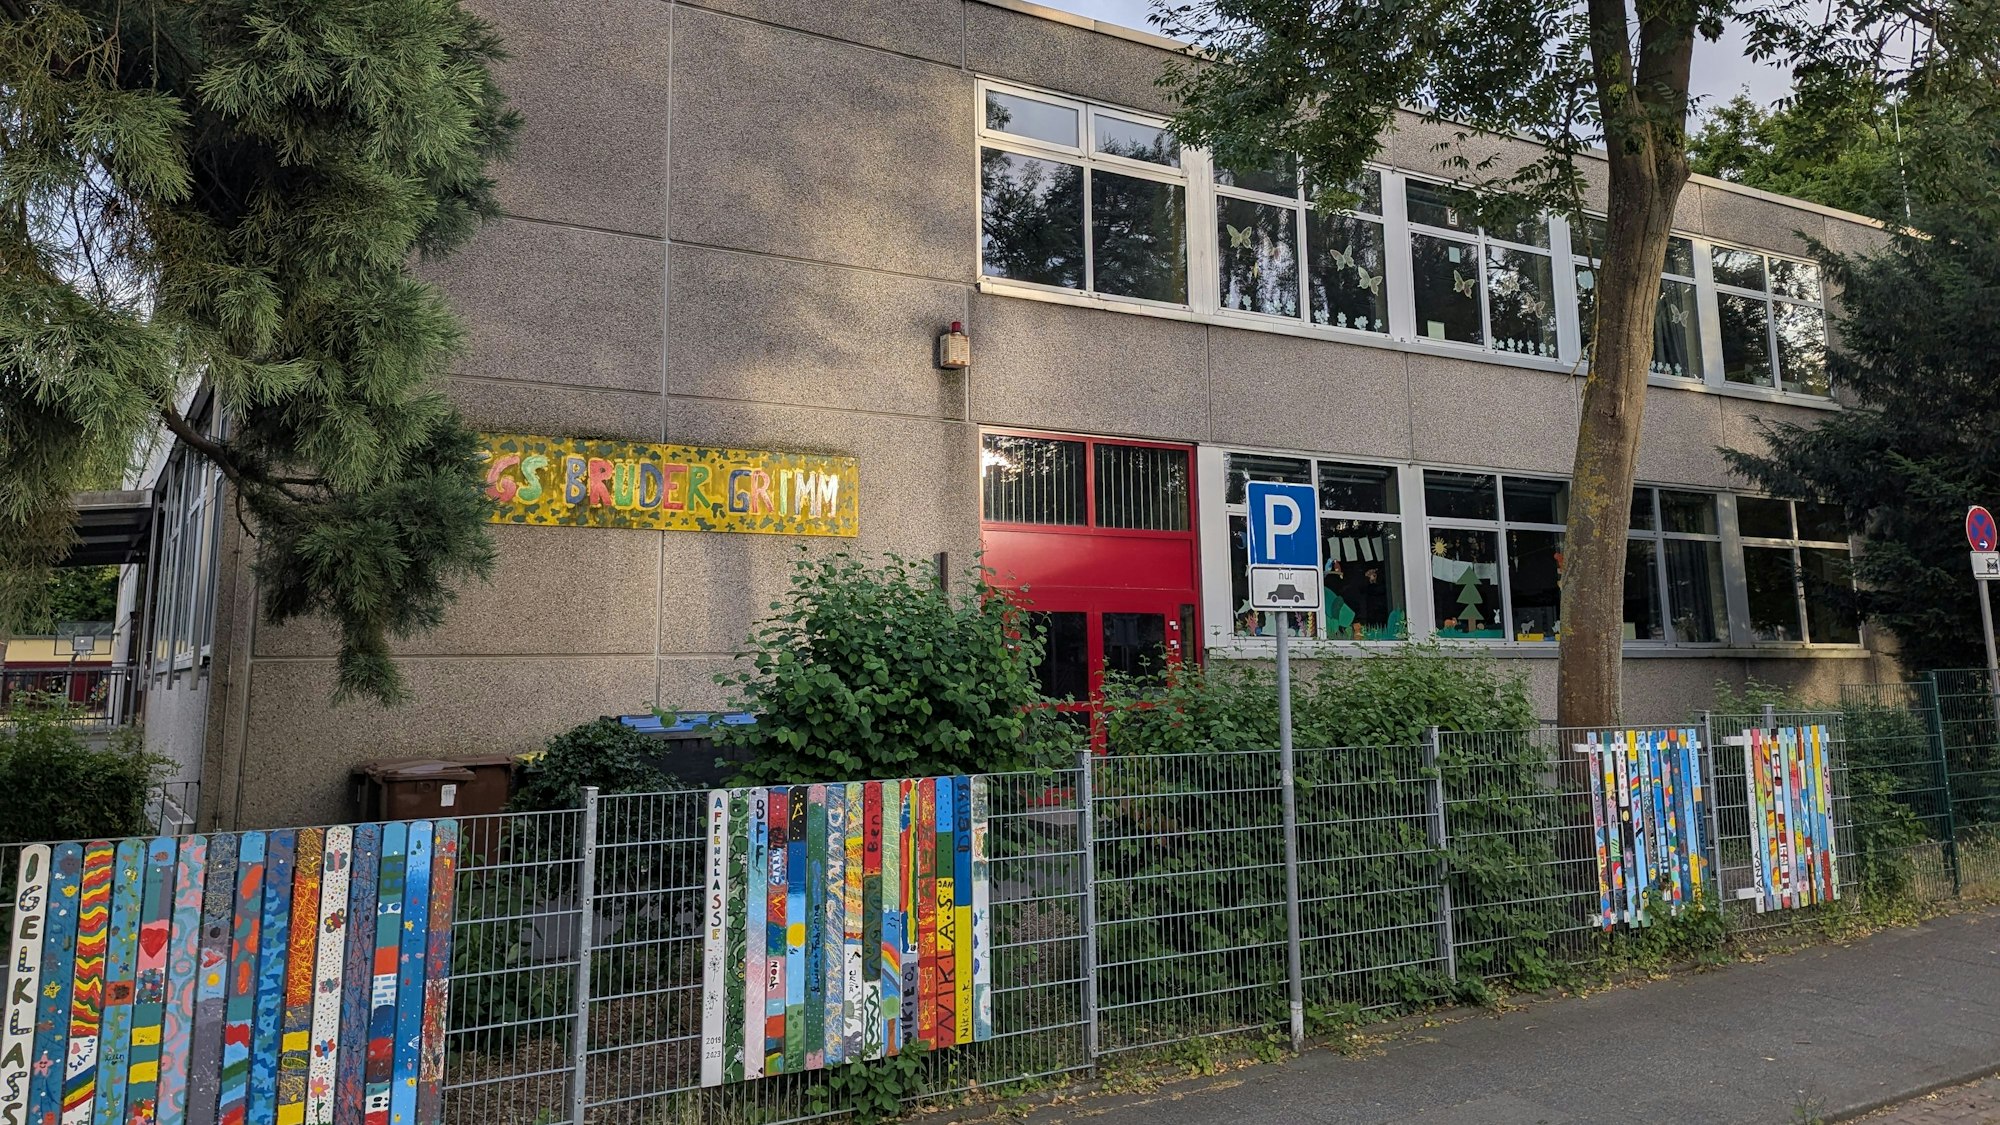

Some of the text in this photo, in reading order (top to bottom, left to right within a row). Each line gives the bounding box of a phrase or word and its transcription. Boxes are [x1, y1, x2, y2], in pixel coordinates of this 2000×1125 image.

[728, 469, 839, 518] GRIMM
[1265, 494, 1301, 560] P
[1279, 572, 1294, 580] nur
[755, 799, 766, 868] BFF
[867, 814, 880, 852] Ben
[710, 797, 723, 940] AFFENKLASSE
[938, 880, 953, 888] JAN
[1754, 850, 1763, 893] PANDA
[768, 961, 780, 990] Noah
[848, 969, 860, 994] Julia
[69, 1038, 95, 1071] Schule
[705, 1050, 721, 1059] 2023
